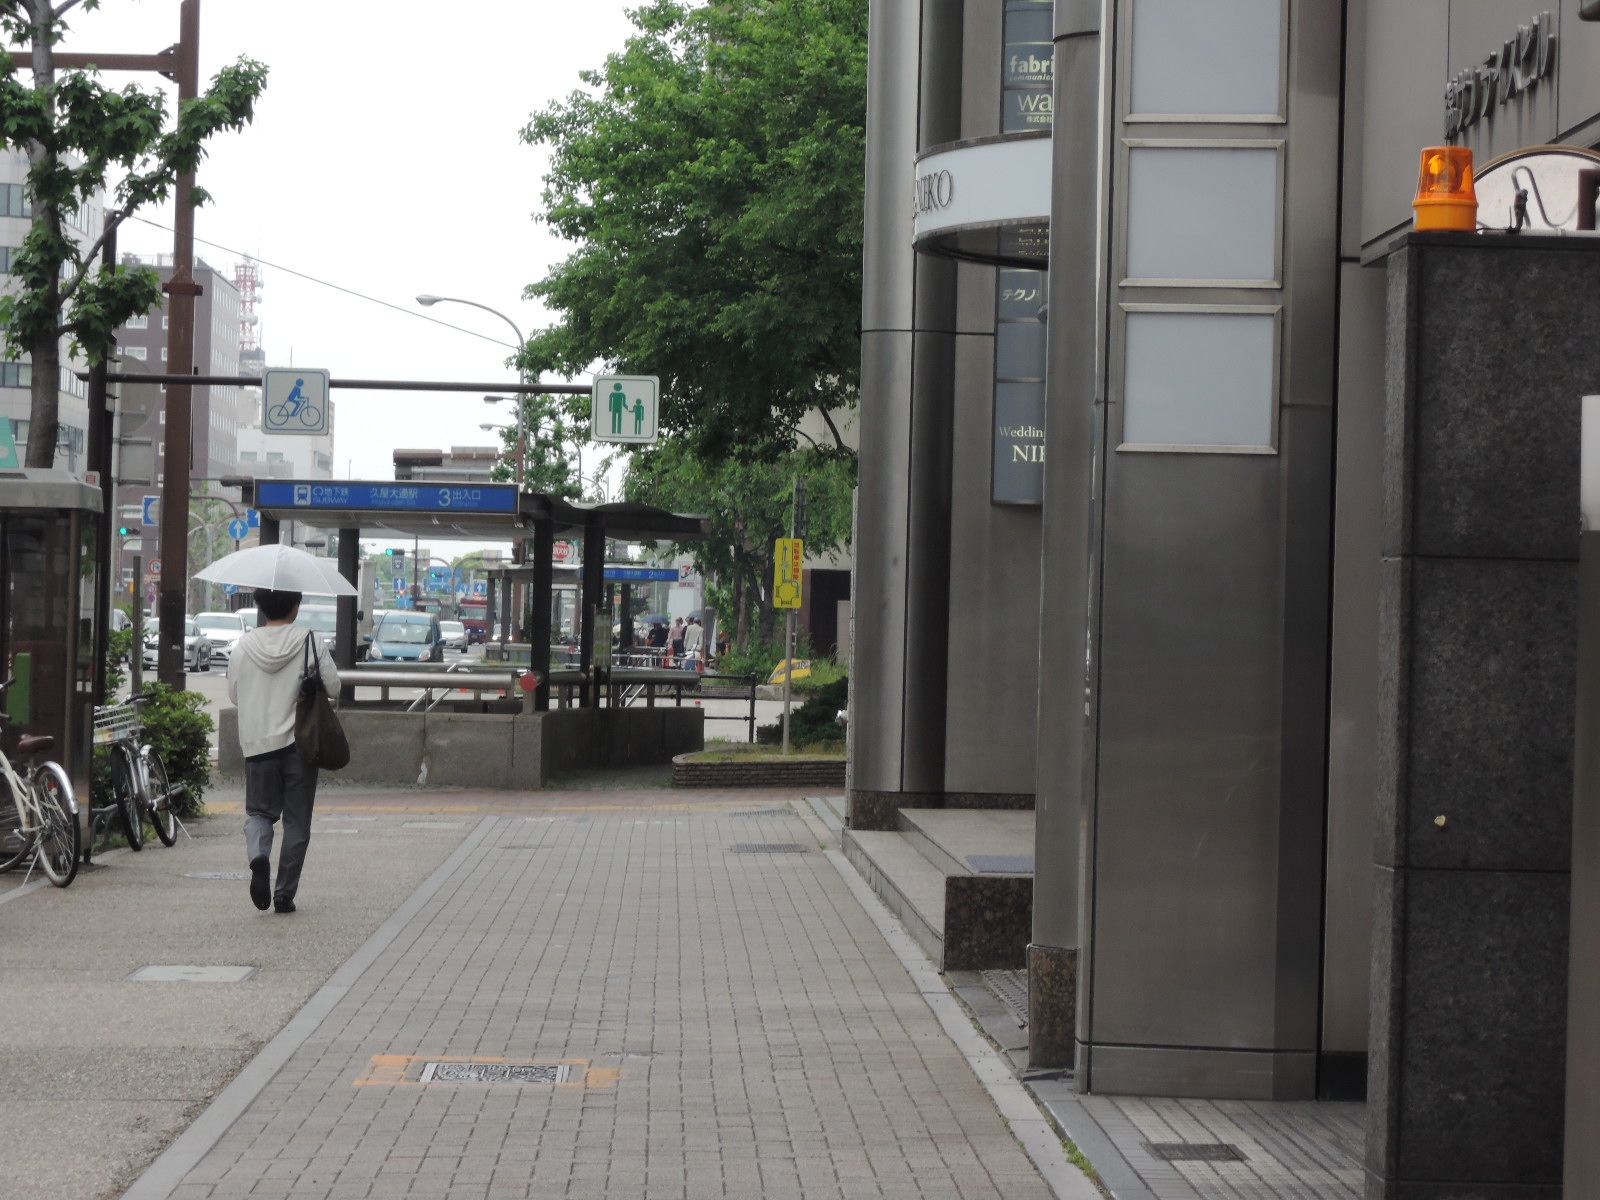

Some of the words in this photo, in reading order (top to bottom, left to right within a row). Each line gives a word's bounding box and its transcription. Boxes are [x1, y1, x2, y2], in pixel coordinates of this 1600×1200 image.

[999, 425, 1046, 438] Weddin
[438, 488, 451, 507] 3
[452, 489, 481, 500] 出入口
